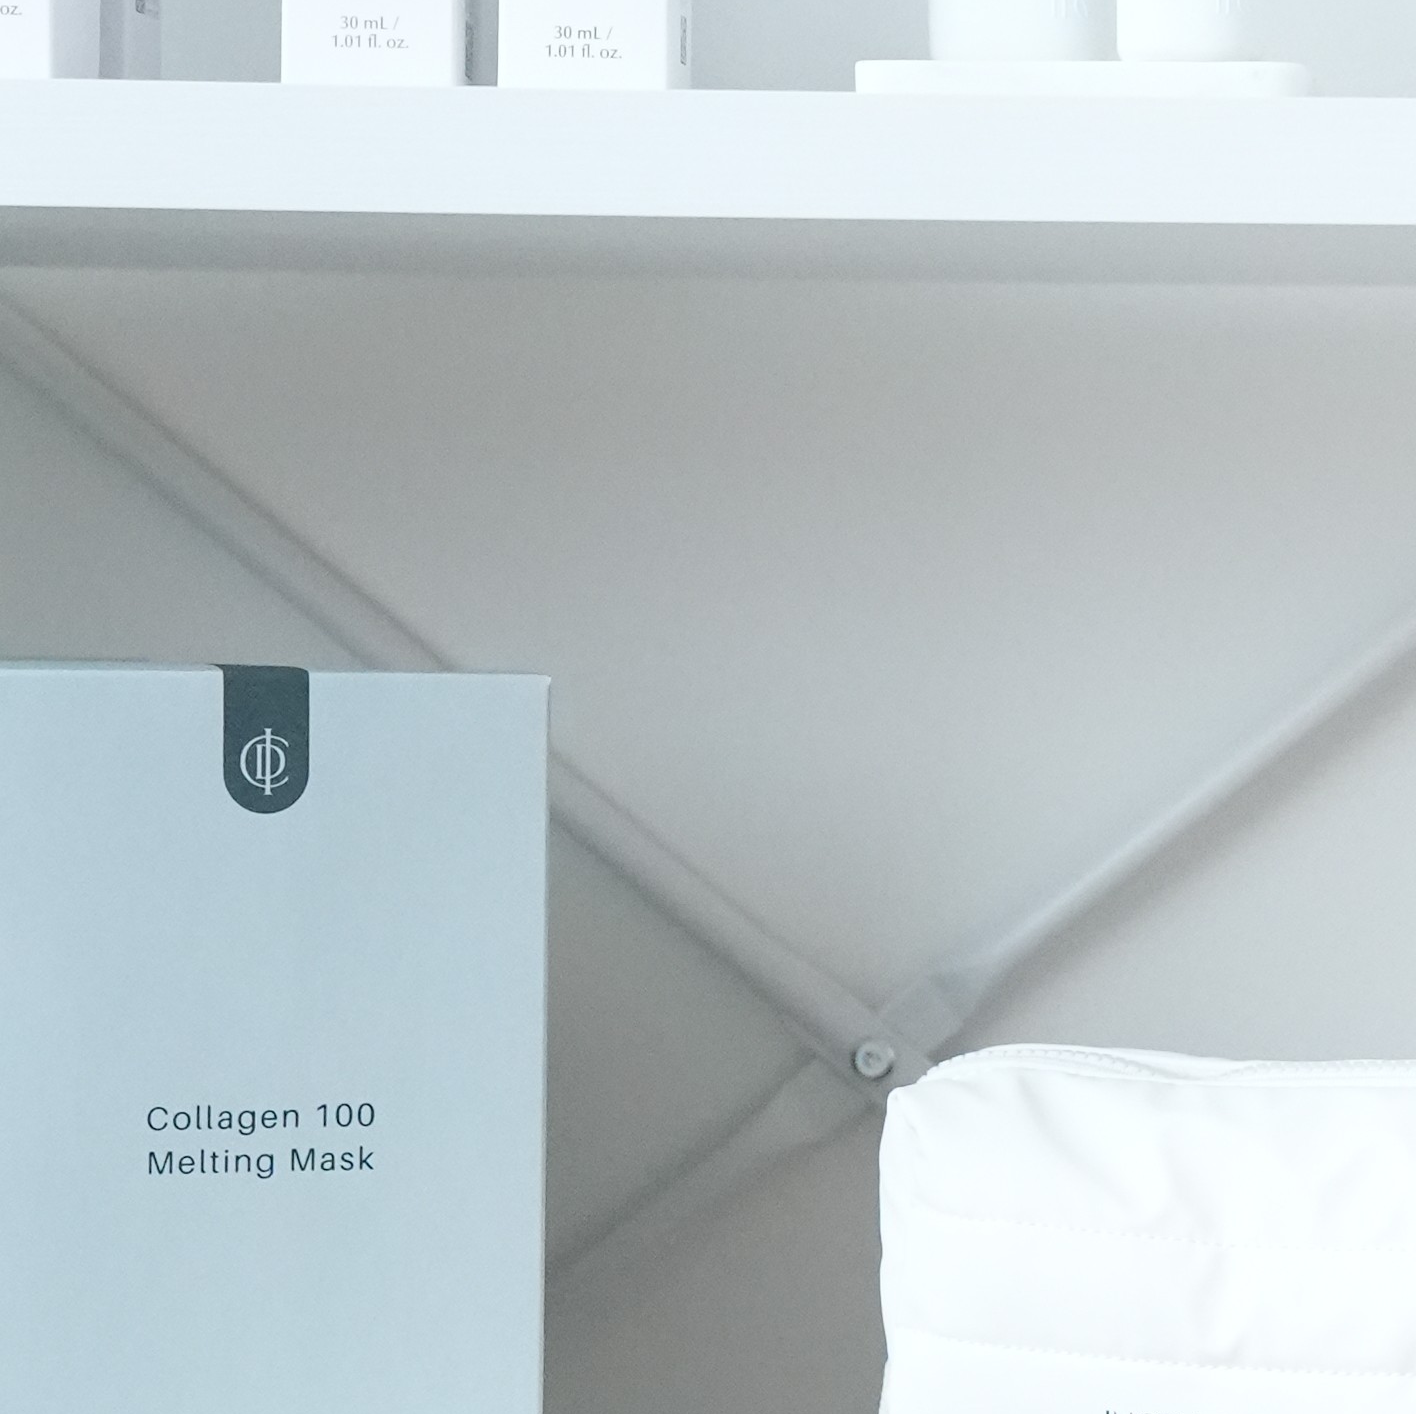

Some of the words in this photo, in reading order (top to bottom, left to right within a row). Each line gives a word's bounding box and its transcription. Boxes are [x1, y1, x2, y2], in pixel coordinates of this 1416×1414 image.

[340, 16, 359, 30] 30
[363, 16, 389, 30] mL
[392, 16, 400, 30] /
[554, 26, 573, 40] 30
[577, 26, 601, 40] mL
[606, 26, 614, 41] /
[331, 35, 362, 49] 1.01
[367, 34, 382, 49] fl.
[386, 38, 409, 50] oz.
[545, 45, 575, 58] 1.01
[581, 44, 595, 58] fl.
[599, 48, 622, 60] oz.
[145, 1102, 302, 1136] Collagen
[315, 1100, 377, 1130] 100
[147, 1146, 276, 1178] Melting
[290, 1144, 375, 1173] Mask
